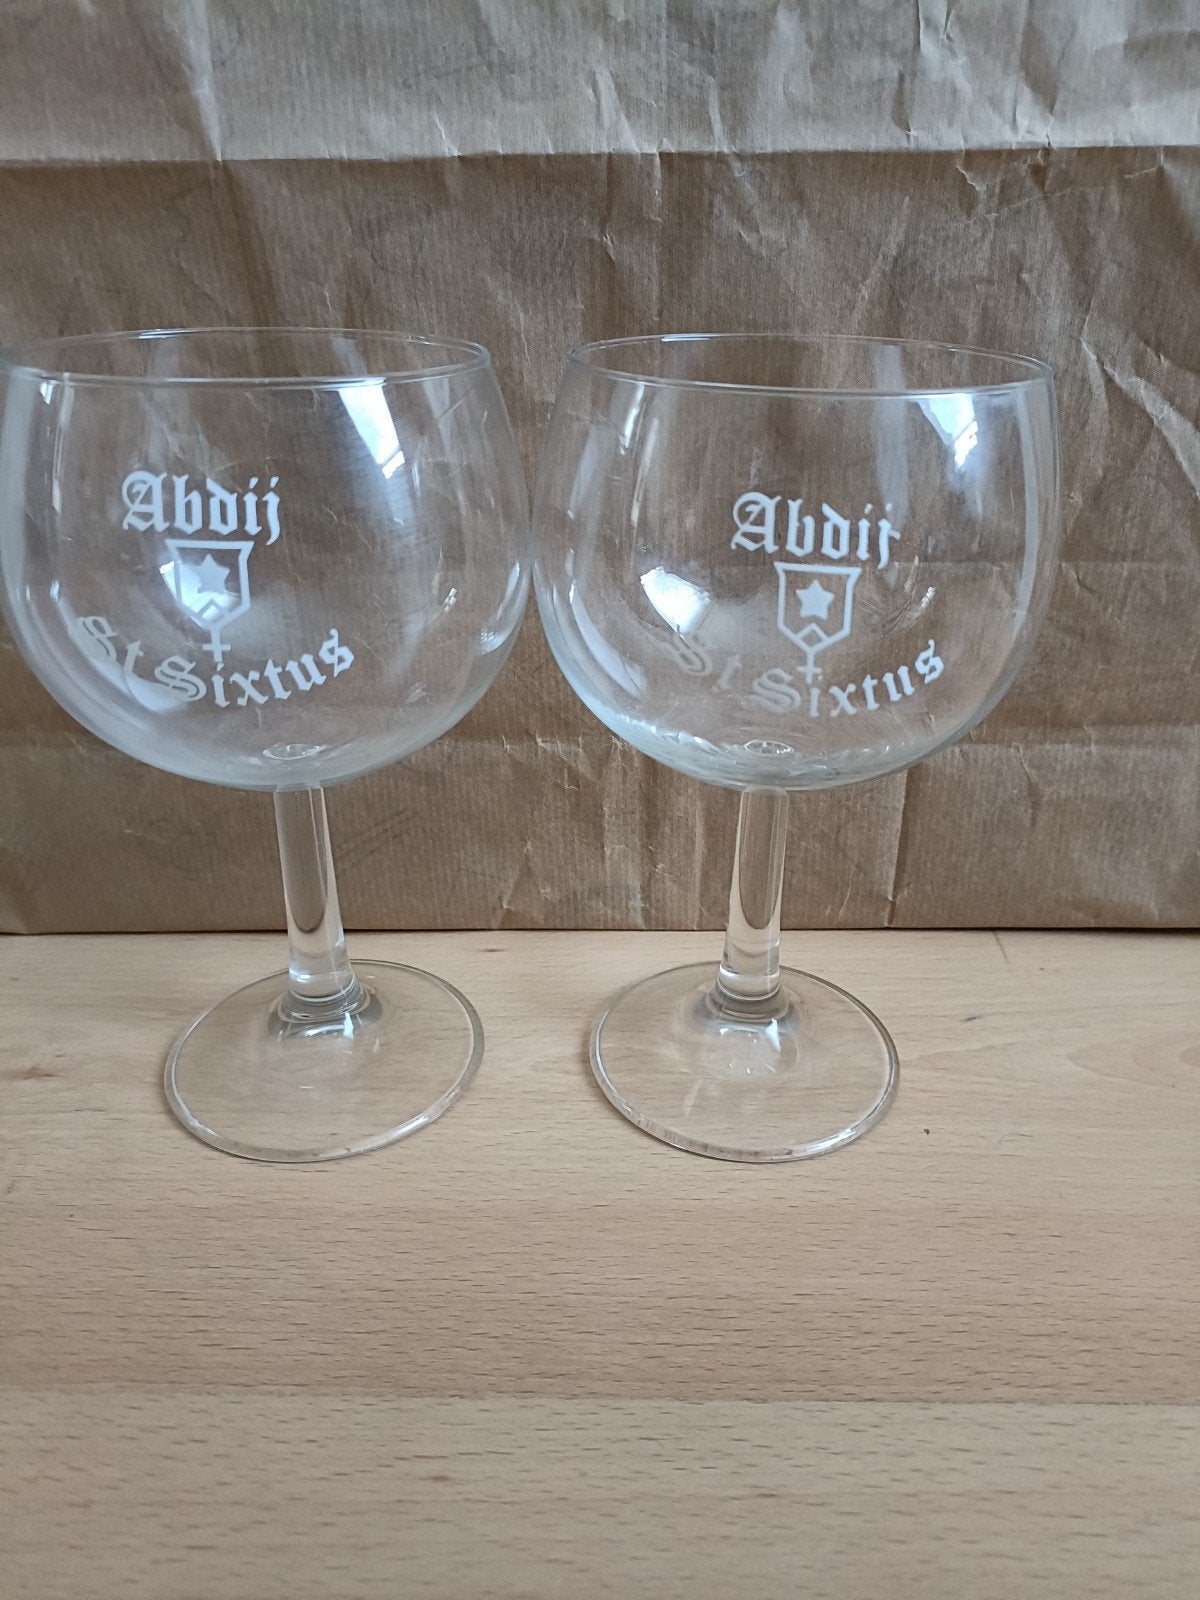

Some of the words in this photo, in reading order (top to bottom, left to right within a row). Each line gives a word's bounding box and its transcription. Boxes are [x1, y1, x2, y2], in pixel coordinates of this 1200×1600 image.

[121, 470, 280, 545] Abdij
[730, 491, 901, 570] Abdij
[77, 615, 145, 688] St
[154, 628, 355, 708] Sixtus
[752, 639, 945, 718] Sixtus
